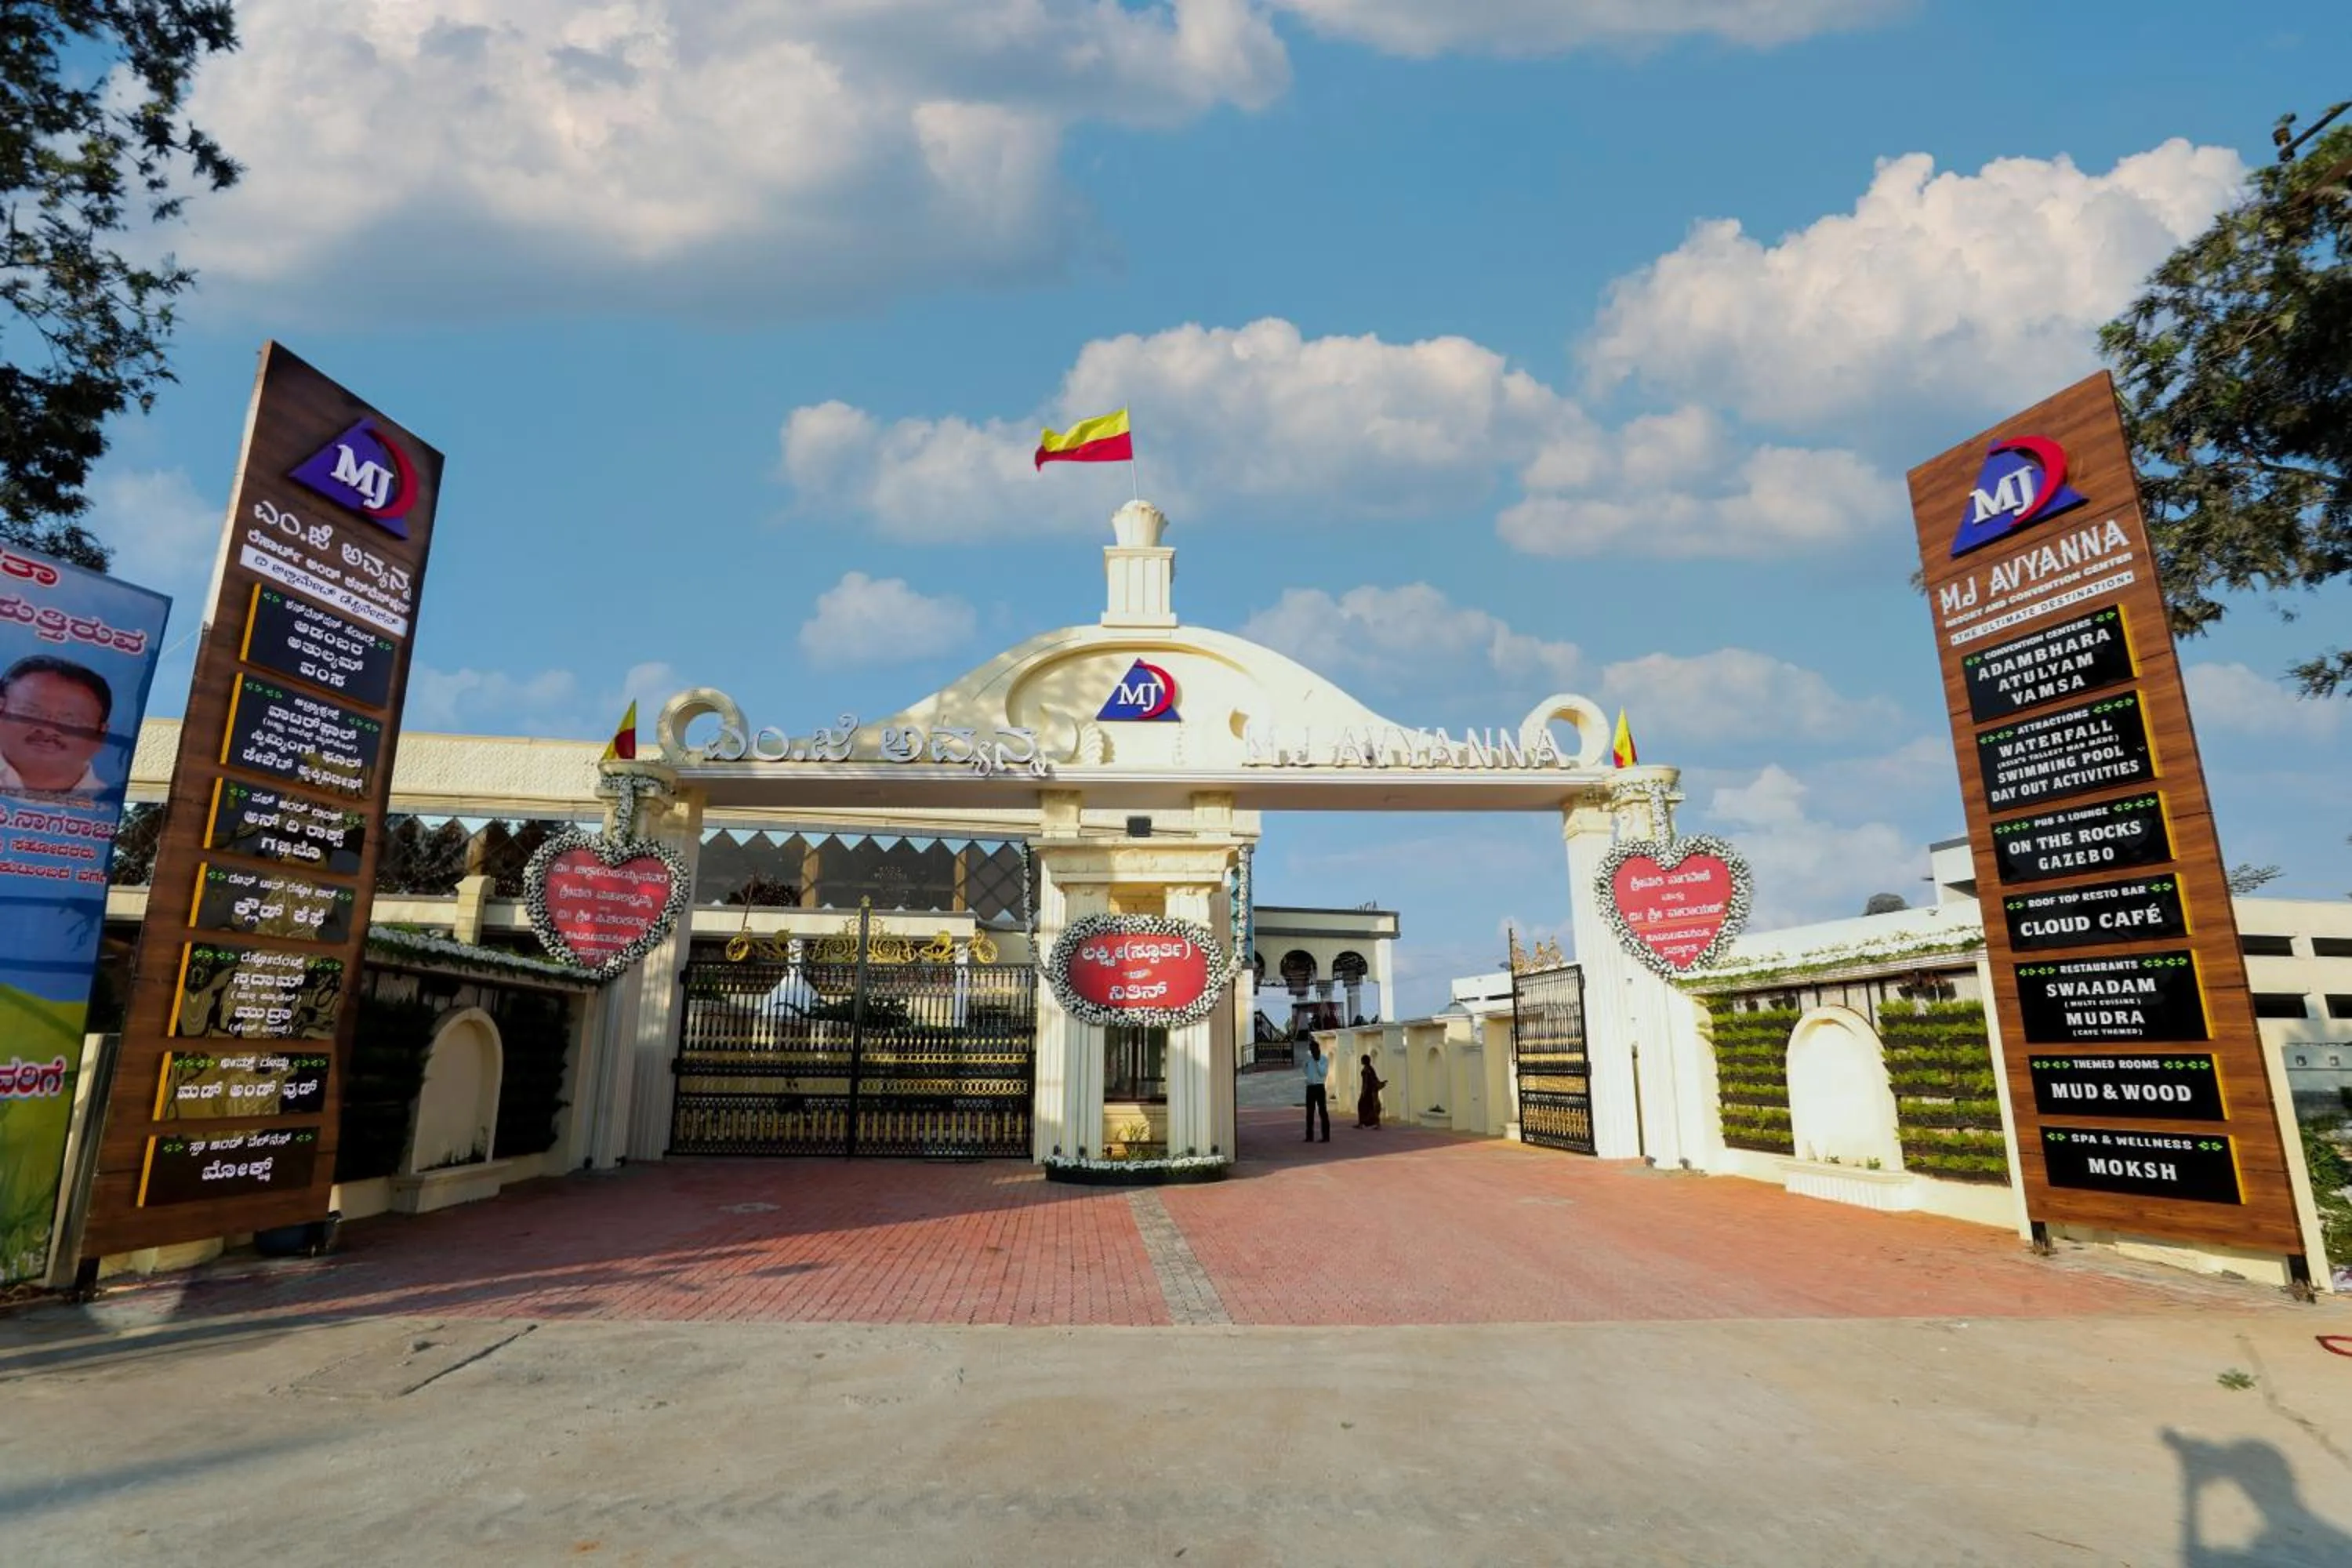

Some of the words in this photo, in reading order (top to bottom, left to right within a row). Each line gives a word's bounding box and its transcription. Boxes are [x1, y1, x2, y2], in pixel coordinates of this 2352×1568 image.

[331, 445, 394, 510] MJ
[1969, 466, 2033, 524] MJ
[1940, 577, 1976, 614] MJ
[1991, 521, 2126, 594] AVYANNA
[1983, 608, 2034, 633] ULTIMATE
[2040, 576, 2125, 611] DESTINATION
[1978, 629, 2109, 680] ADAMBHARA
[1984, 634, 2043, 659] CONVENTION
[2045, 619, 2091, 638] CENTERS
[1998, 652, 2092, 691] ATULYAM
[1116, 682, 1161, 713] MJ
[2011, 675, 2084, 704] VAMSA
[706, 713, 859, 762] ಎಂ.ಜೆ
[2017, 709, 2088, 734] ATTRACTIONS
[1334, 725, 1570, 770] AVYANNA
[1998, 720, 2111, 757] WATERFALL
[1998, 756, 2075, 782] SWIMMING
[2082, 746, 2123, 764] POOL
[1991, 786, 2016, 802] DAY
[2020, 779, 2048, 795] OUT
[2053, 760, 2138, 788] ACTIVITIES
[2034, 816, 2054, 826] PUB
[2056, 815, 2065, 823] &
[2067, 807, 2108, 821] LOUNGE
[2009, 840, 2031, 854] ON
[2036, 832, 2072, 849] THE
[2078, 820, 2140, 842] ROCKS
[2038, 847, 2114, 869] GAZEBO
[2027, 896, 2055, 907] ROOF
[2058, 893, 2079, 903] TOP
[2082, 888, 2118, 900] RESTO
[2121, 885, 2145, 895] BAR
[2020, 916, 2089, 936] CLOUD
[2099, 903, 2161, 927] CAFÉ
[2060, 960, 2137, 973] RESTAURANTS
[2046, 978, 2154, 996] SWAADAM
[2066, 1010, 2143, 1025] MUDRA
[2073, 1059, 2114, 1069] THEMED
[2118, 1059, 2159, 1069] ROOMS
[2051, 1083, 2097, 1098] MUD
[2103, 1083, 2118, 1099] &
[2121, 1083, 2190, 1101] WOOD
[2071, 1134, 2096, 1143] SPA
[2101, 1134, 2111, 1144] &
[2115, 1136, 2191, 1149] WELLNESS
[2088, 1158, 2176, 1180] MOKSH
